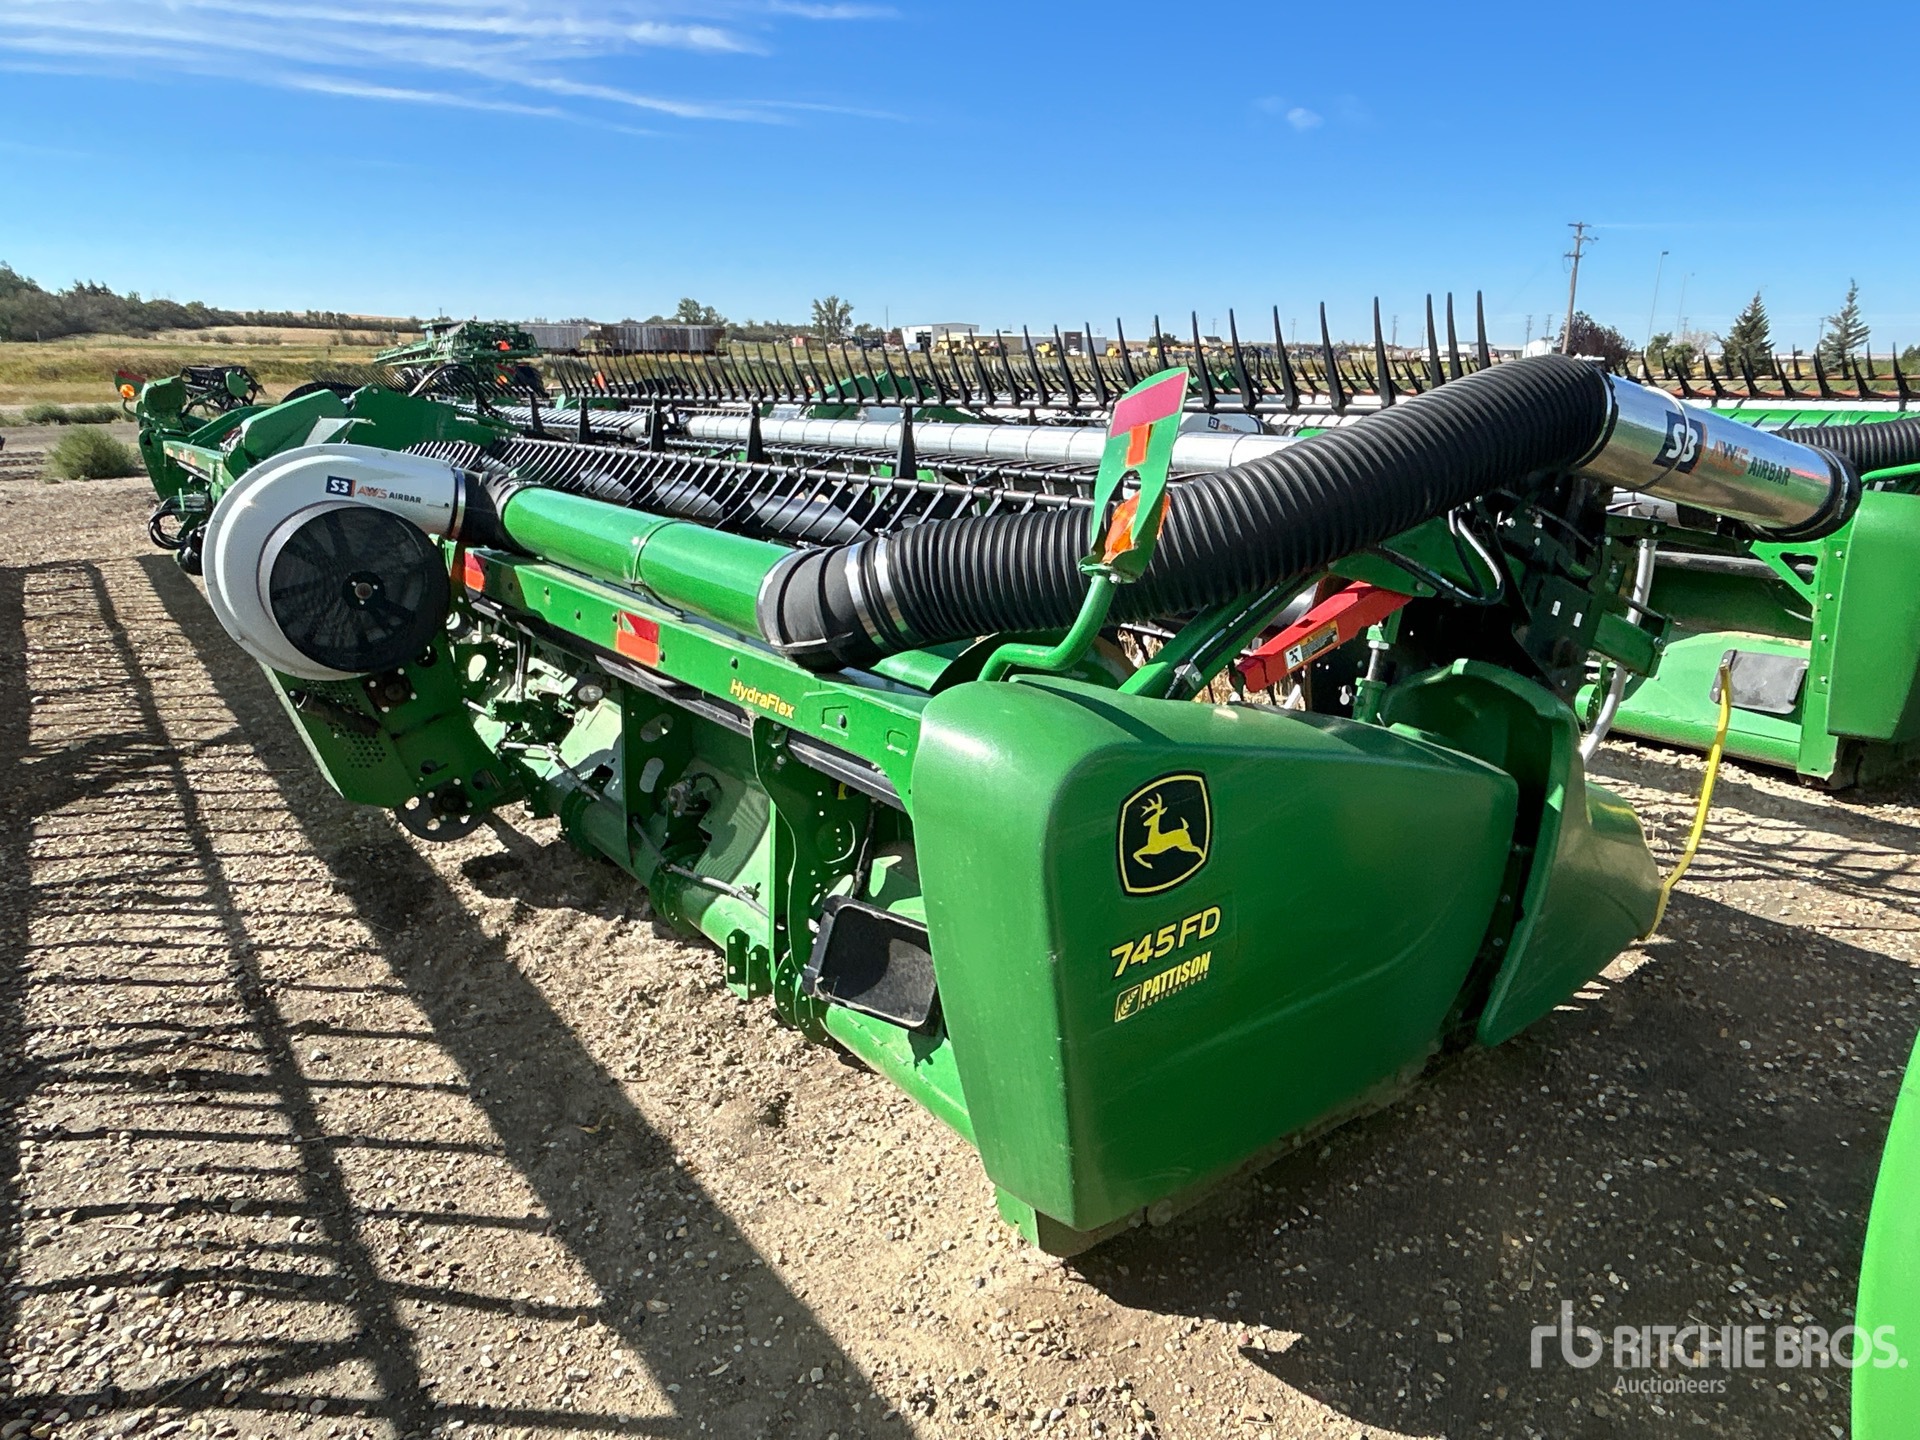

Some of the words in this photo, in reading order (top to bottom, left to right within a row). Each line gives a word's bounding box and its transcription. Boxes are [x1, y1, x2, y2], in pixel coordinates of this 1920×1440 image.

[1665, 423, 1699, 463] S3
[1748, 456, 1792, 486] AIRBAR
[330, 479, 349, 493] S3
[357, 485, 388, 499] AWS
[388, 492, 422, 504] AIRBAR
[729, 678, 795, 719] HydraFlex
[1111, 906, 1221, 977] 745FD
[1141, 951, 1212, 1002] PATTISON
